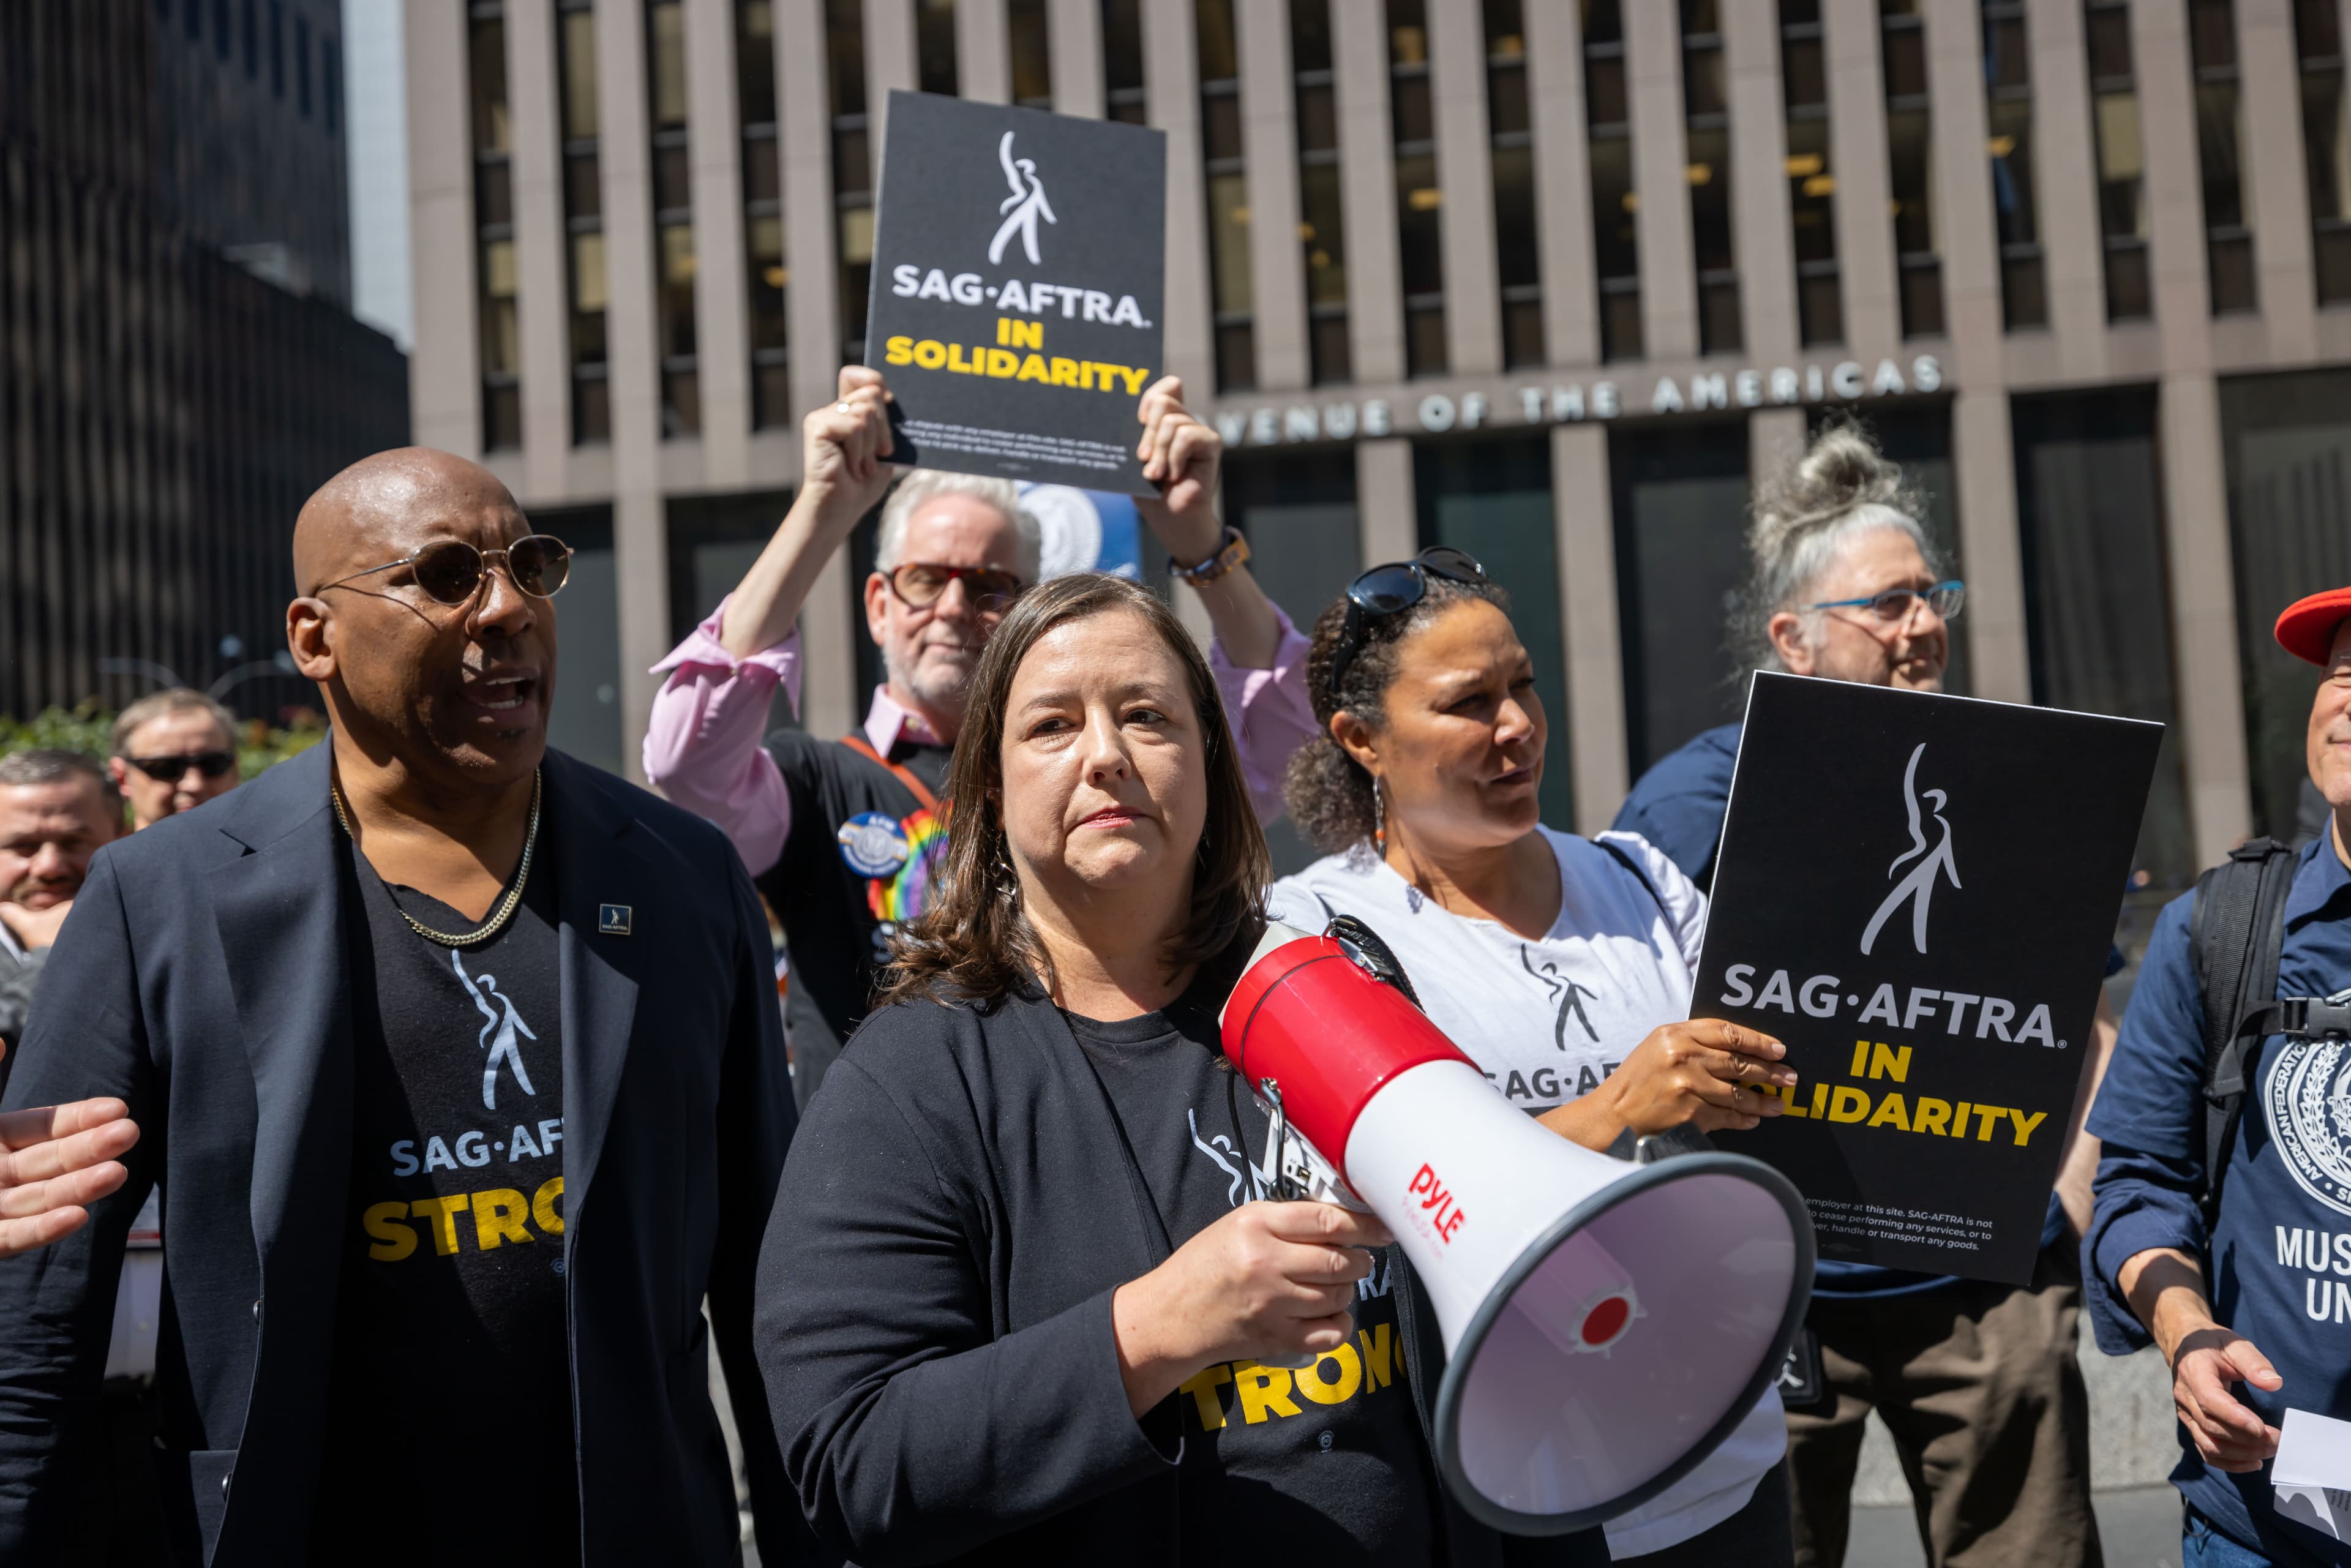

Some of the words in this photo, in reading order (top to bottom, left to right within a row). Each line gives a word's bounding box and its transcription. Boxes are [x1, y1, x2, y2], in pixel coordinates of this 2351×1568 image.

[997, 317, 1044, 350] IN
[885, 336, 1150, 396] SOLIDARITY
[1193, 399, 1392, 448] VENUE
[1418, 391, 1488, 433] OF
[1518, 380, 1621, 424] THE
[1652, 354, 1941, 415] AMERICAS
[1850, 1040, 1913, 1082] IN
[1738, 1081, 2048, 1146] LIDARITY
[2279, 1117, 2323, 1182] AMERICAN
[1805, 1198, 1851, 1209] employer
[1866, 1205, 1884, 1214] this
[1886, 1207, 1905, 1217] site.
[1908, 1210, 1963, 1225] SAG-AFTRA
[1966, 1217, 1974, 1226] is
[1819, 1212, 1847, 1221] cease
[1848, 1216, 1903, 1230] performing
[1906, 1223, 1924, 1232] any
[1925, 1225, 1966, 1237] services,
[1832, 1225, 1865, 1236] handle
[1880, 1230, 1925, 1242] transport
[1927, 1237, 1946, 1247] any
[1947, 1240, 1979, 1250] goods.
[1179, 1322, 1408, 1431] TRON
